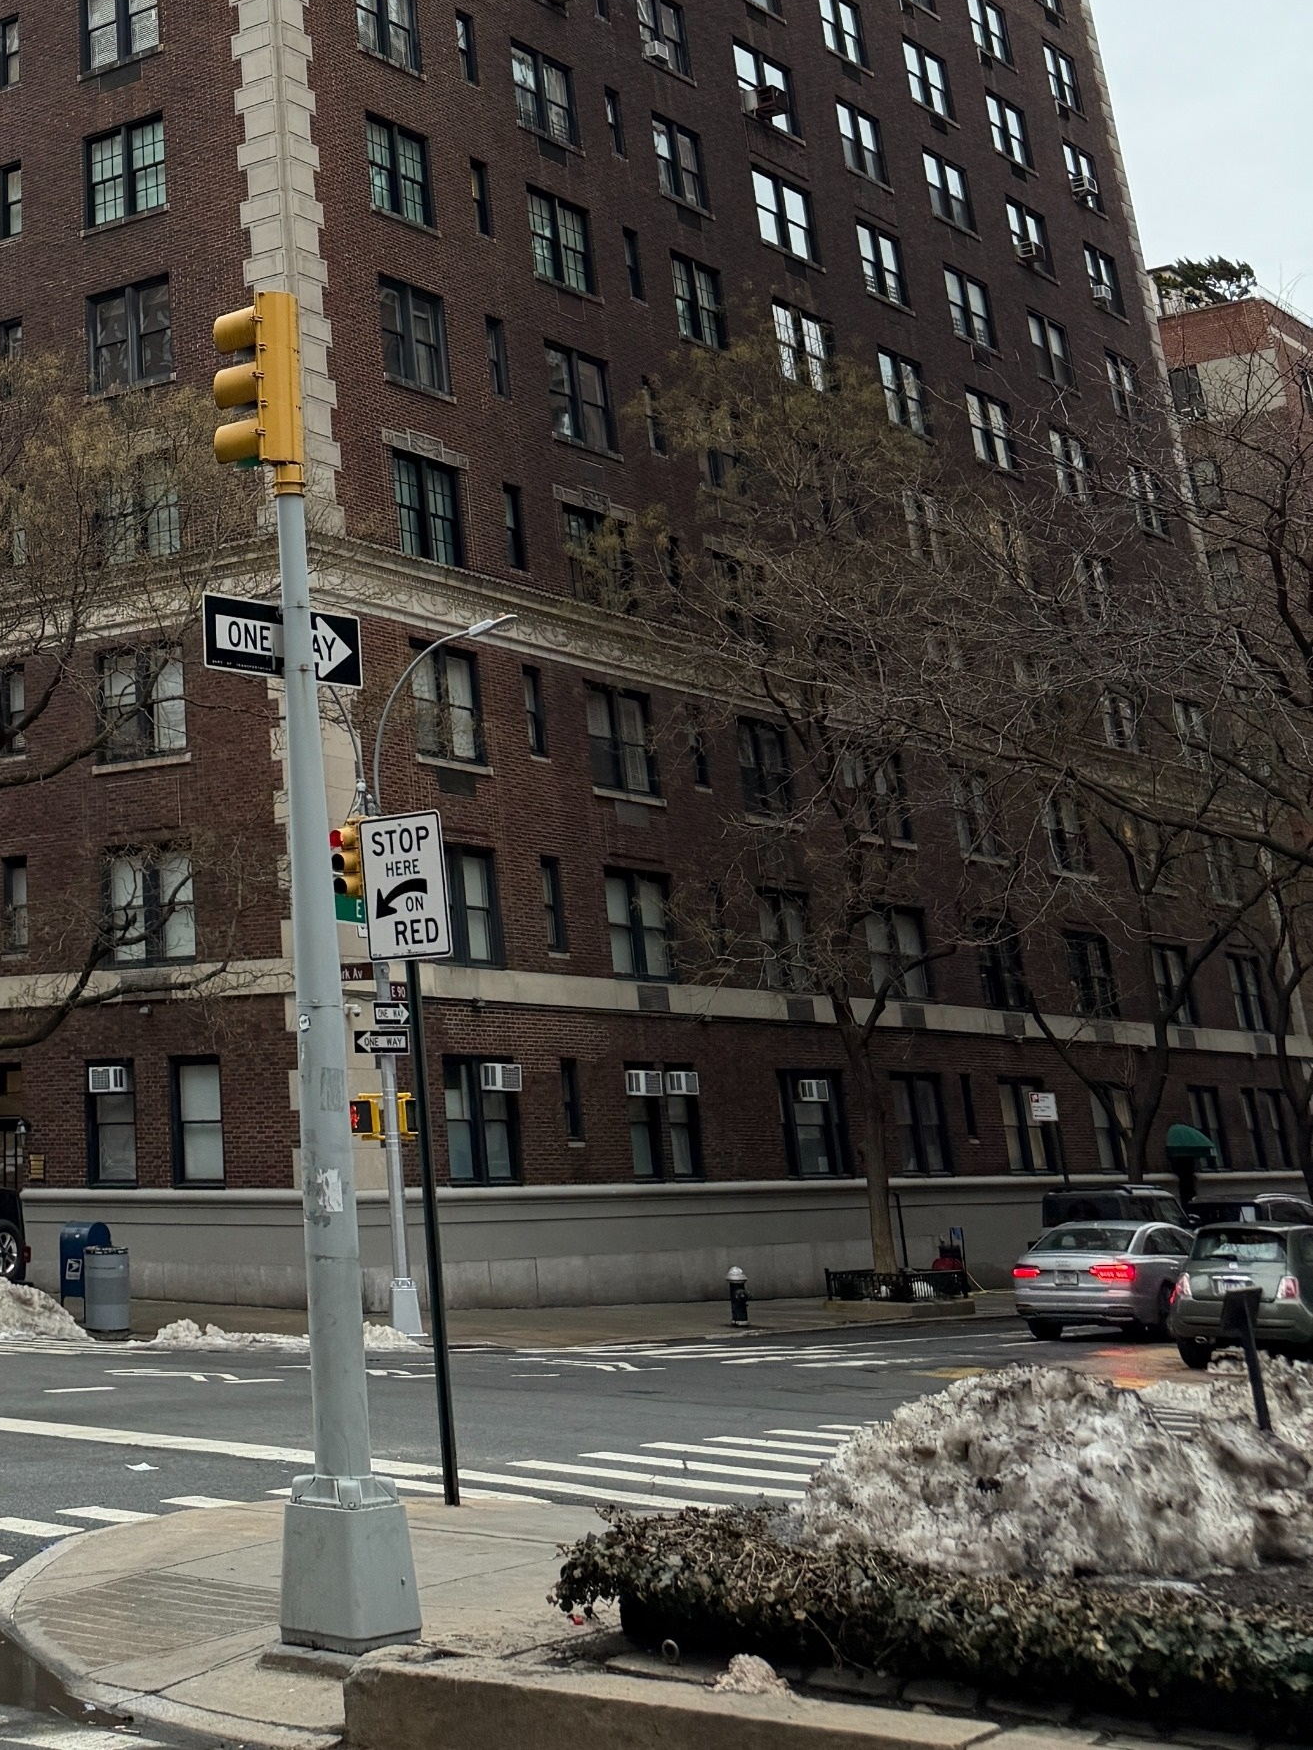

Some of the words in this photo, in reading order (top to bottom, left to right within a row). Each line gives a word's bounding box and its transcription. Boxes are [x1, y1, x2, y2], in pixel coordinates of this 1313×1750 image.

[228, 620, 272, 653] ONE
[312, 634, 337, 662] AY
[371, 825, 430, 857] STOP
[385, 858, 421, 878] HERE
[356, 898, 363, 918] E
[405, 895, 424, 912] ON
[394, 917, 439, 946] RED
[342, 968, 351, 980] rk
[353, 967, 363, 980] Av
[391, 986, 397, 998] E
[378, 1008, 389, 1018] ONE
[393, 1009, 404, 1018] WAY
[364, 1037, 380, 1047] ONE
[386, 1037, 403, 1047] WAY
